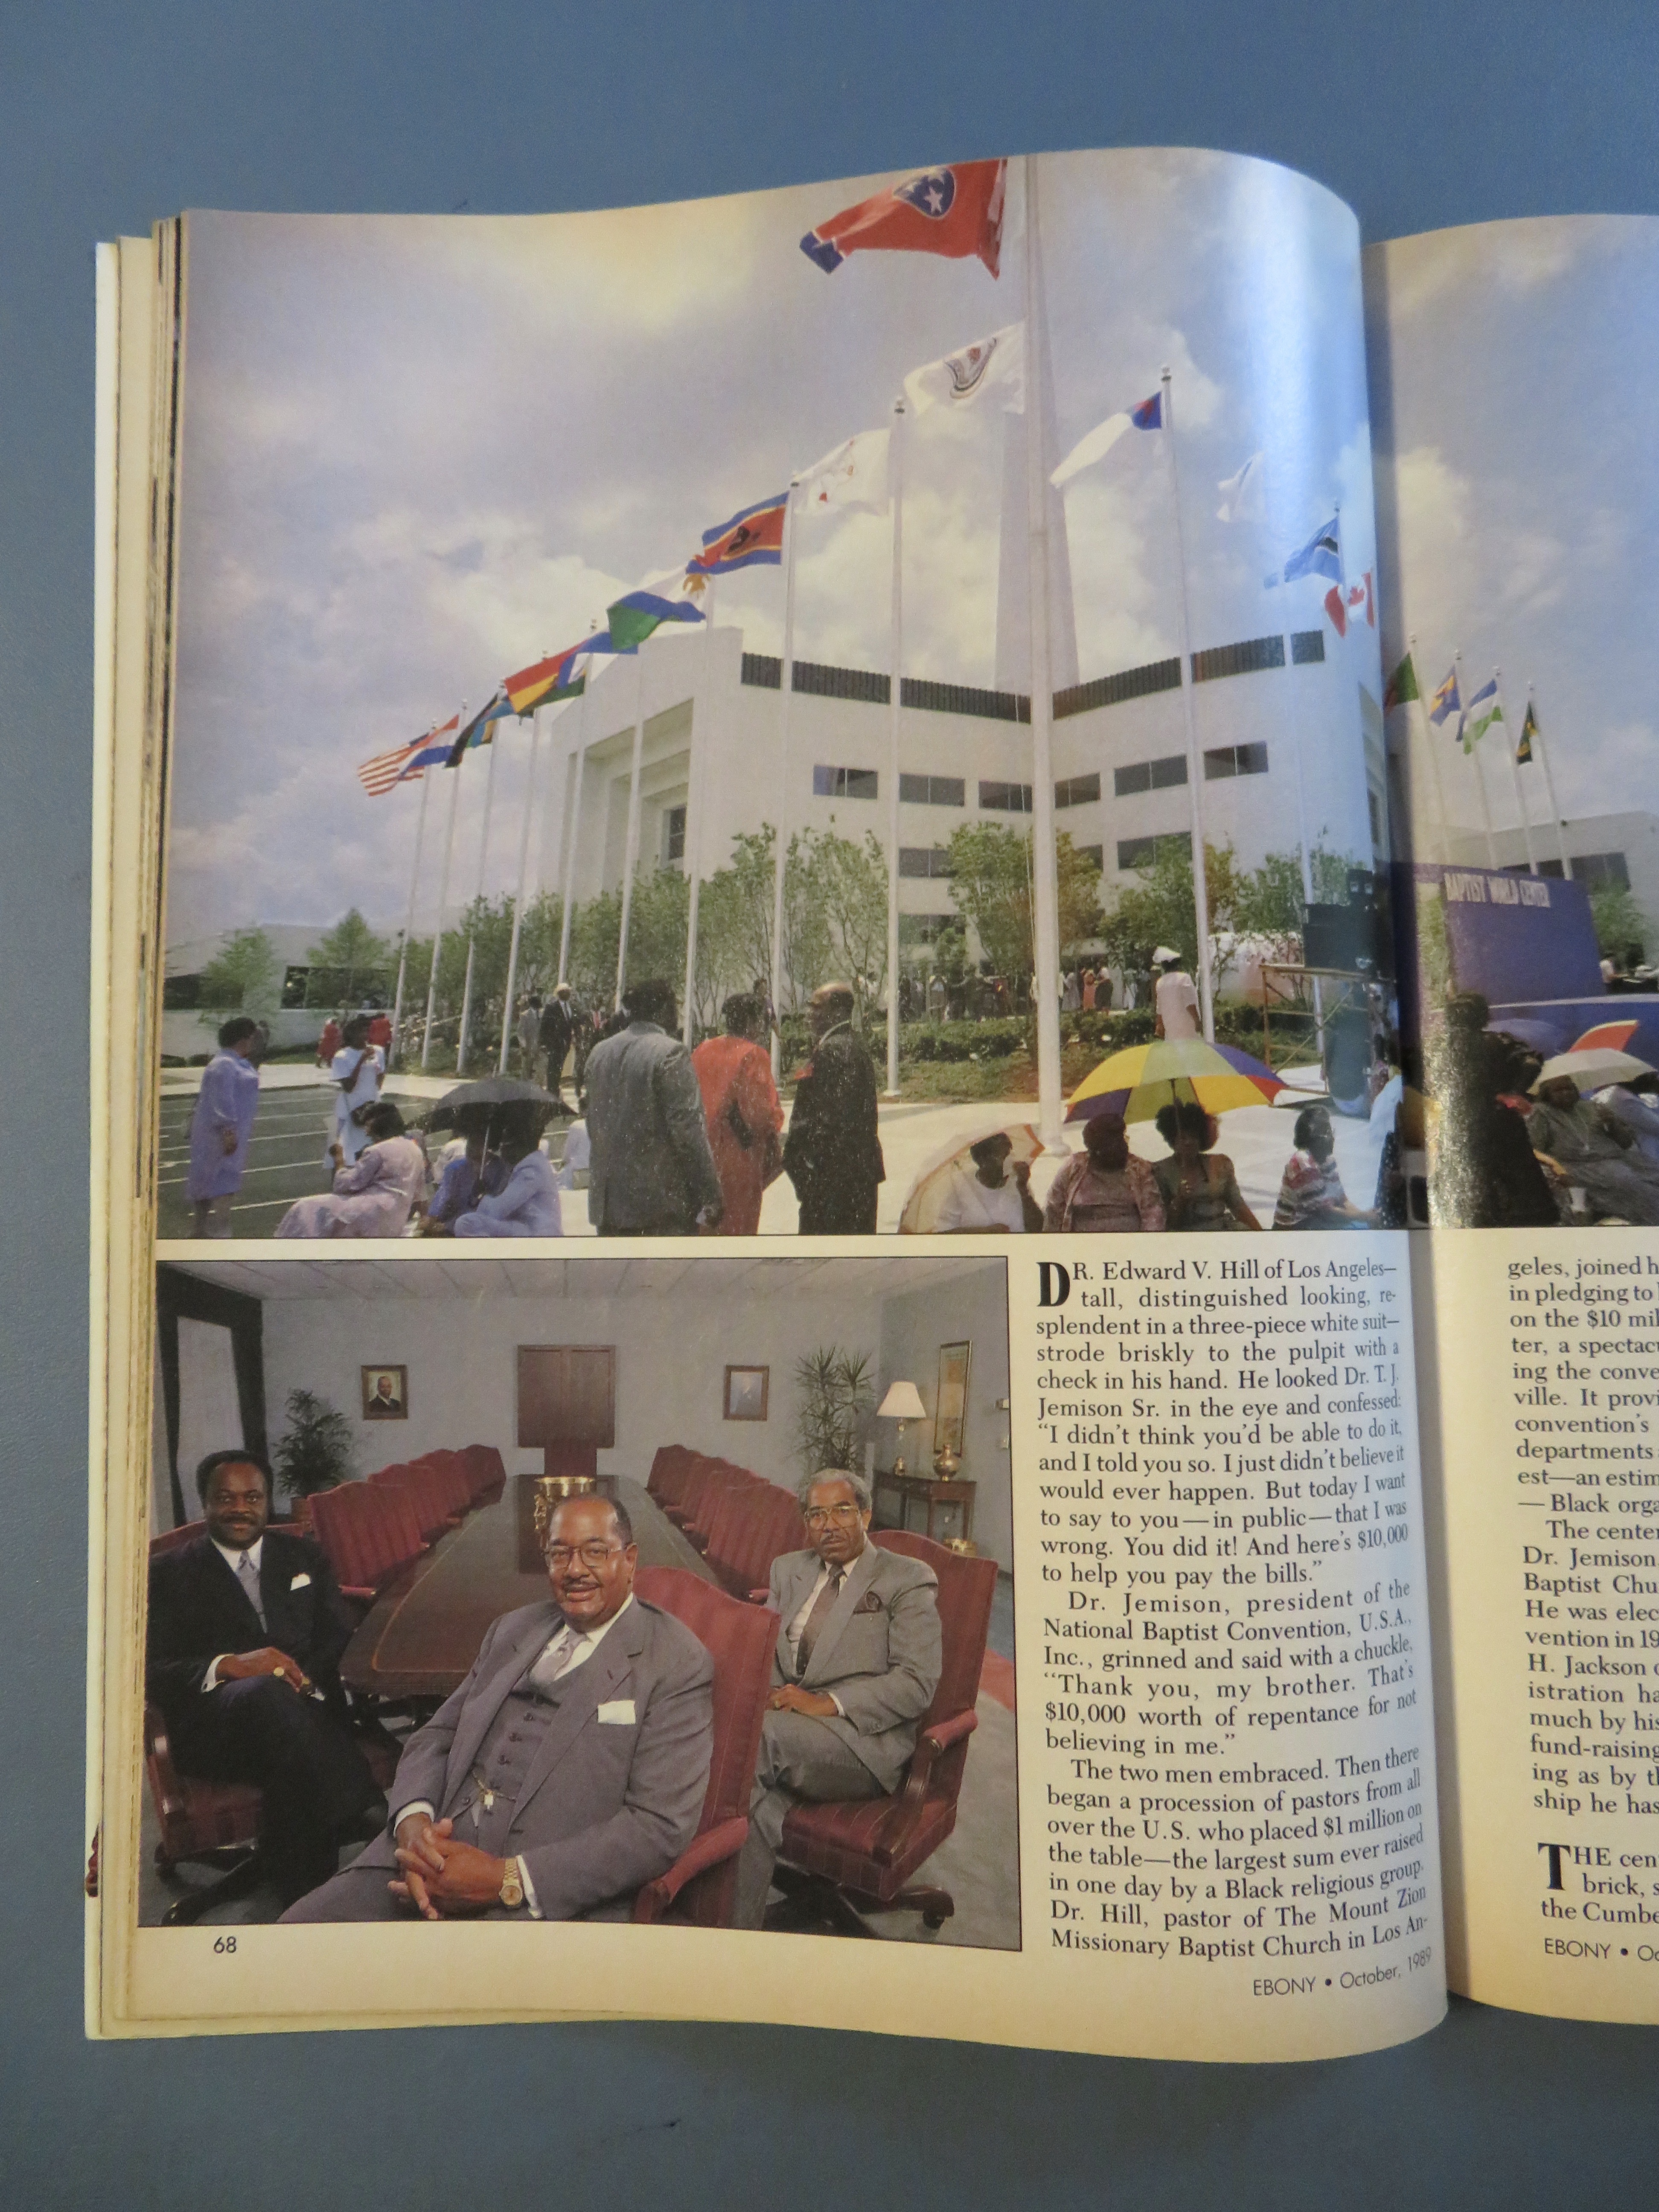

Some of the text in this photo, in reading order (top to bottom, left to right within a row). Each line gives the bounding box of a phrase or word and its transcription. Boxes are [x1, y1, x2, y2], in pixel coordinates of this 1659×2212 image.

[1103, 1260, 1186, 1280] Edward
[1192, 1261, 1211, 1279] V.
[1220, 1259, 1259, 1279] Hill
[1288, 1260, 1321, 1278] Los
[1508, 1256, 1642, 1280] geles, joined
[1081, 1285, 1395, 1312] tall, distinguished looking, re-
[1510, 1282, 1653, 1306] in pledging to
[1037, 1312, 1358, 1339] splendent three-piece white
[1511, 1308, 1621, 1329] on the $10
[1037, 1336, 1386, 1367] strode briskly pulpit with
[1512, 1338, 1547, 1355] ter,
[1037, 1366, 1369, 1389] check his hand. looked Dr.
[1513, 1360, 1591, 1384] ing the
[1038, 1398, 1122, 1420] Jemison
[1243, 1403, 1278, 1421] eye
[1514, 1386, 1598, 1406] ville. It
[1067, 1421, 1339, 1449] didn't think you'd able
[1515, 1414, 1649, 1433] convention's
[1097, 1447, 1393, 1477] told just didn't believe
[1516, 1438, 1654, 1464] departments
[1039, 1476, 1357, 1505] would ever happen. But today
[1551, 1493, 1610, 1512] Black
[1070, 1514, 1101, 1531] say
[1545, 1519, 1589, 1539] The
[1041, 1524, 1408, 1560] wrong. You did it! And here's $10,000
[1523, 1546, 1557, 1565] Dr.
[1071, 1562, 1213, 1589] help pay
[1524, 1572, 1601, 1597] Baptist
[1069, 1589, 1353, 1618] Dr. Jemison, president
[1526, 1600, 1607, 1620] He was
[1044, 1618, 1133, 1639] National
[1143, 1621, 1218, 1646] Baptist
[1227, 1620, 1351, 1637] Convention,
[1525, 1630, 1634, 1648] vention in
[1044, 1646, 1092, 1669] Inc.,
[1103, 1648, 1187, 1672] grinned
[1242, 1647, 1282, 1669] said
[1289, 1644, 1333, 1666] with
[1528, 1653, 1646, 1678] H. Jackson
[1148, 1659, 1413, 1702] you, brother. That's
[1528, 1681, 1624, 1703] istration
[1046, 1701, 1358, 1730] $10,000 worth repentance
[1530, 1708, 1626, 1735] much by
[1046, 1728, 1145, 1758] believing
[1071, 1747, 1418, 1783] The two men embraced. Then there
[1532, 1763, 1636, 1790] ing as by
[1047, 1781, 1402, 1816] began procession pastors from
[1534, 1788, 1617, 1816] ship he
[1048, 1808, 1404, 1846] over U.S. who placed $1 million
[1215, 1822, 1423, 1875] largest sum ever raised
[1077, 1879, 1115, 1894] one
[1124, 1874, 1162, 1902] day
[1225, 1877, 1284, 1898] Black
[1292, 1874, 1374, 1899] religious
[1582, 1873, 1644, 1898] brick,
[1051, 1887, 1426, 1931] Dr. Hill, pastor The Mount Zion
[1541, 1898, 1577, 1920] the
[214, 1936, 236, 1953] 68
[1052, 1916, 1427, 1962] Missionary Baptist Church Los An-
[1545, 1938, 1611, 1959] EBONY
[1254, 1946, 1432, 1996] EBONY October, 1989
